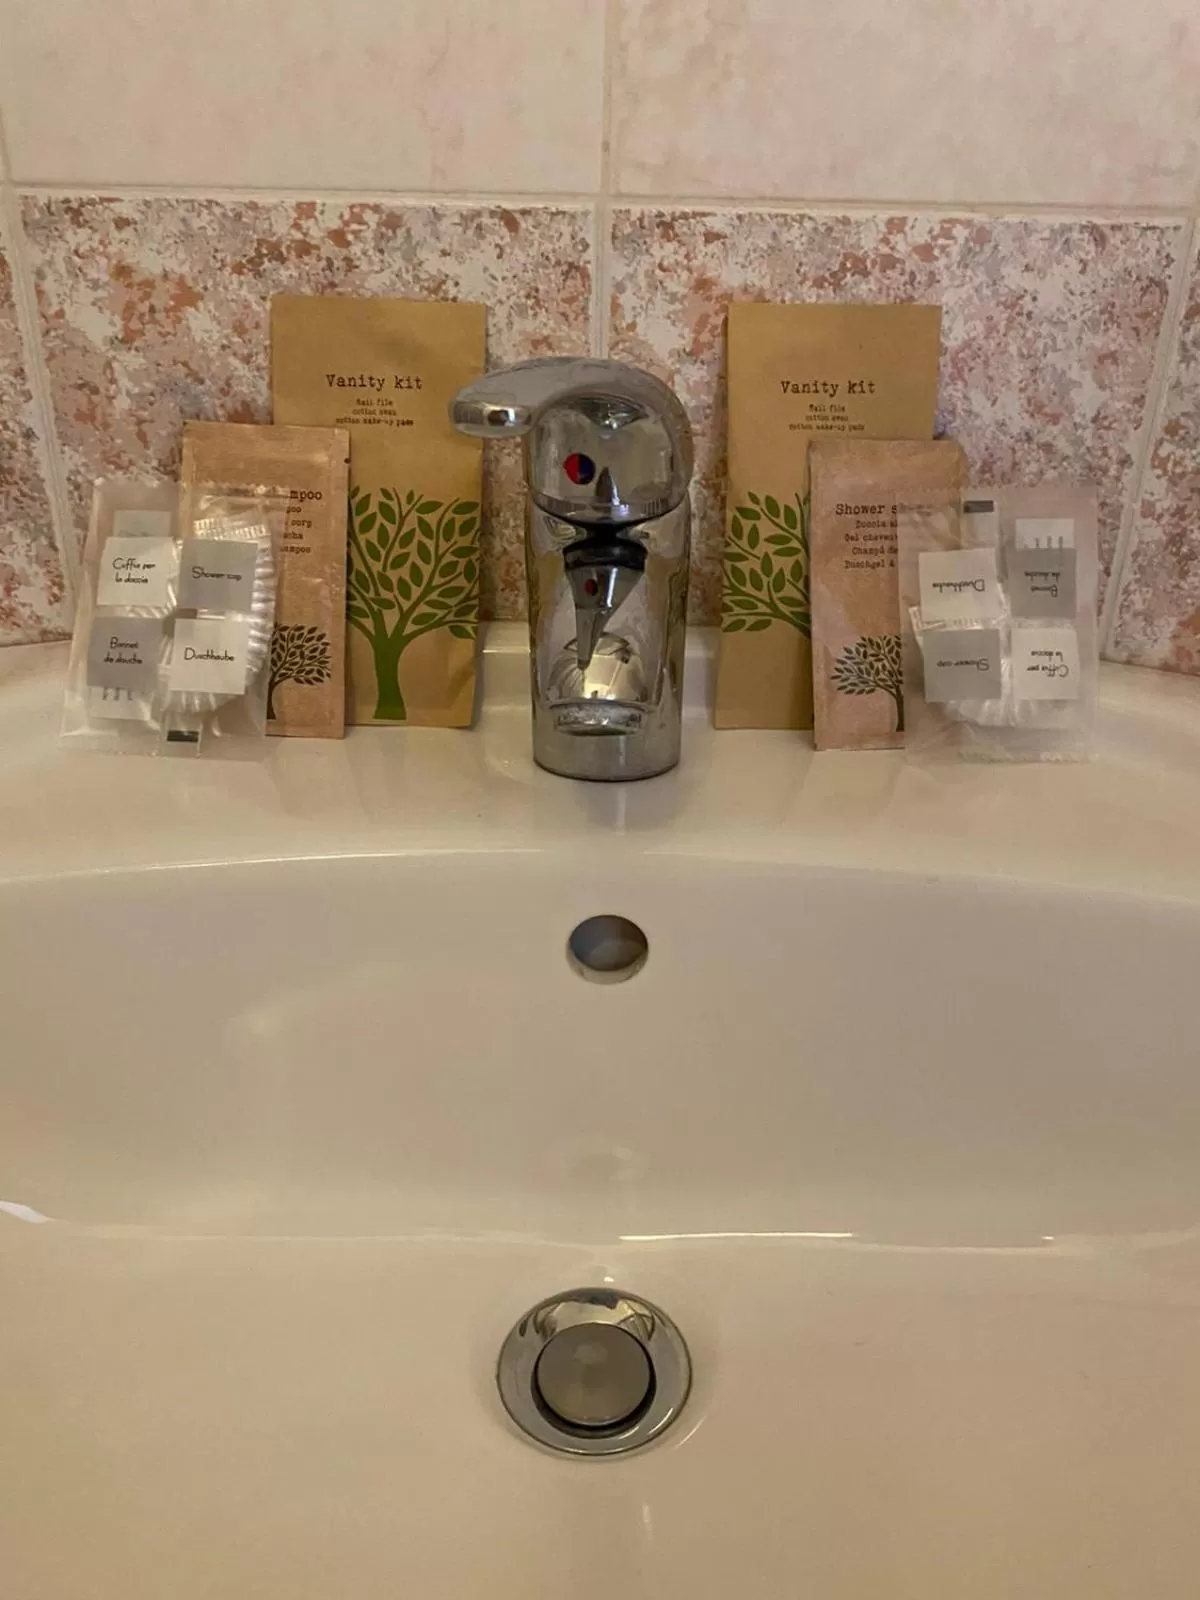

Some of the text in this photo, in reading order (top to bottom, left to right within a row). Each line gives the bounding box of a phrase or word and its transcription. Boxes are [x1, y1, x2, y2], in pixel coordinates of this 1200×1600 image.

[325, 373, 423, 392] Vanity kit
[780, 379, 876, 398] Vanity kit
[290, 490, 323, 502] mpoo
[835, 503, 886, 516] Shower
[844, 559, 885, 570] Duschgel
[191, 565, 225, 580] Shower
[109, 635, 140, 650] Bonnet
[103, 651, 114, 664] de
[183, 646, 236, 662] Duschhaube
